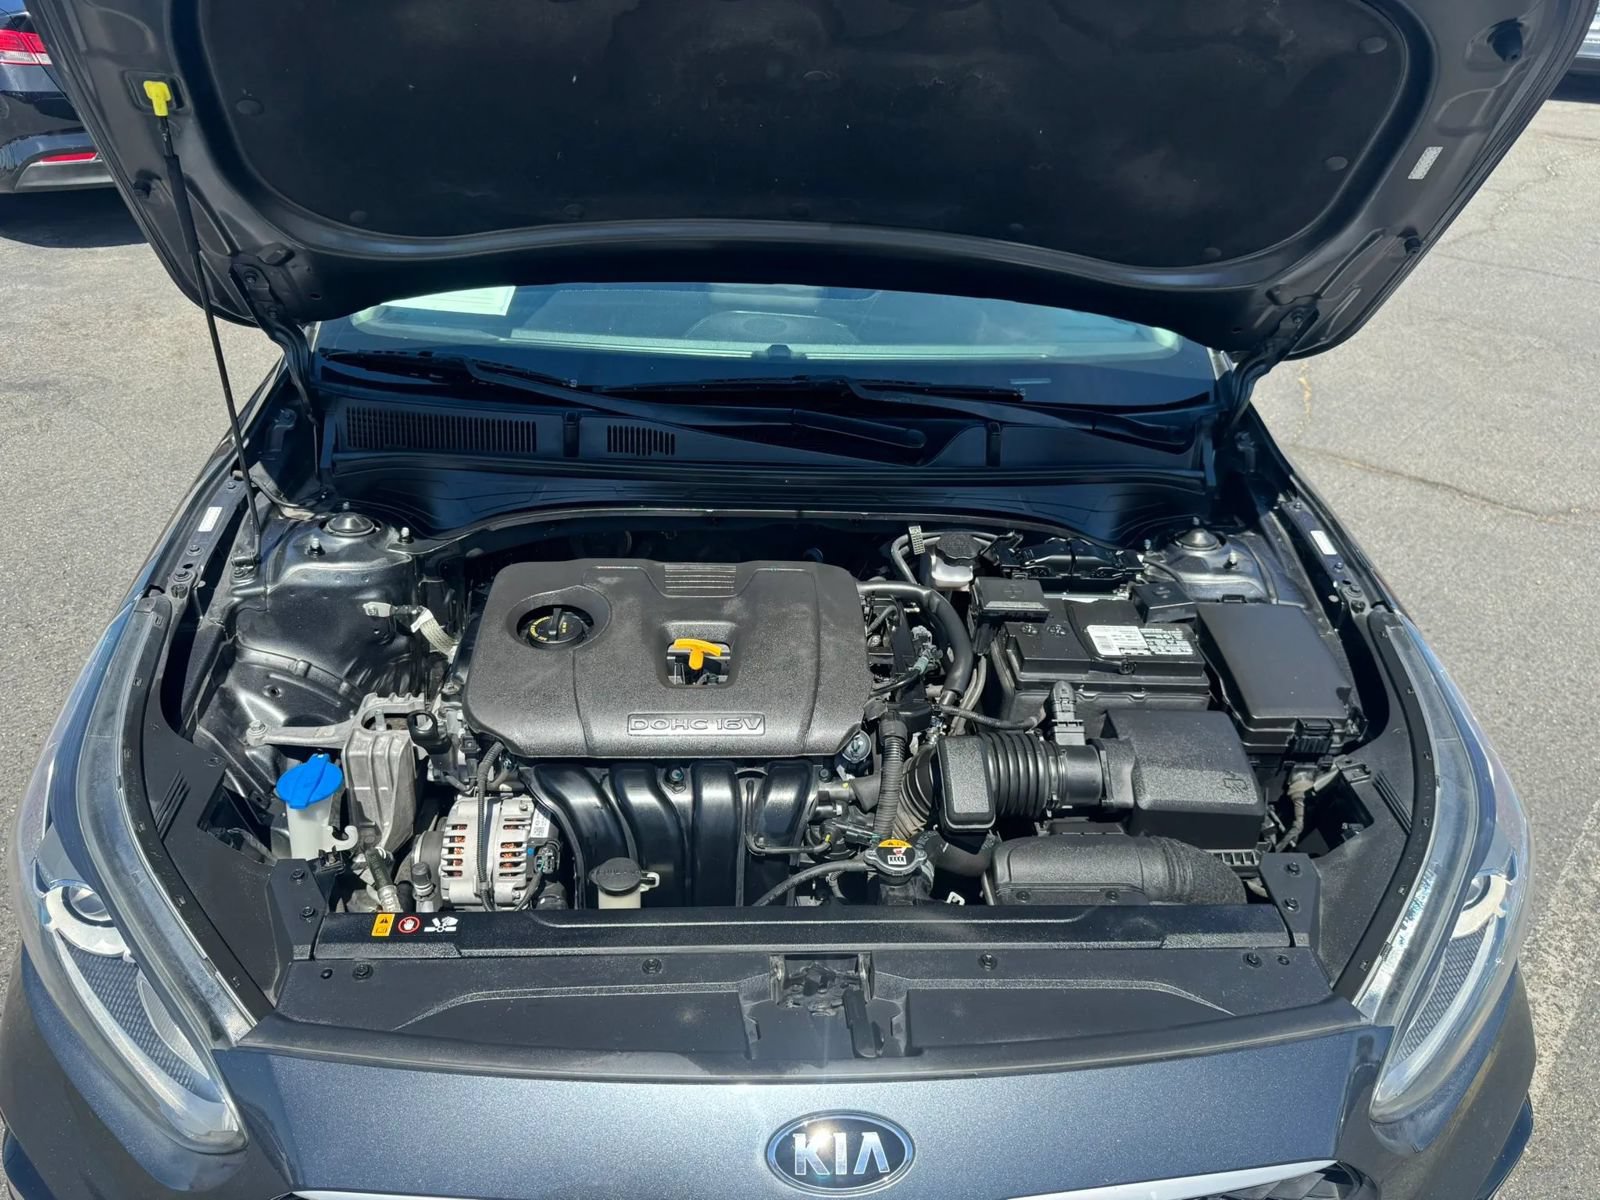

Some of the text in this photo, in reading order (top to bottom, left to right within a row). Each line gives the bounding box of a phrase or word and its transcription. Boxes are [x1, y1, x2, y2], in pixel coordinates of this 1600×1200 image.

[630, 718, 762, 731] DOHC 16V
[792, 1131, 890, 1176] KIA
